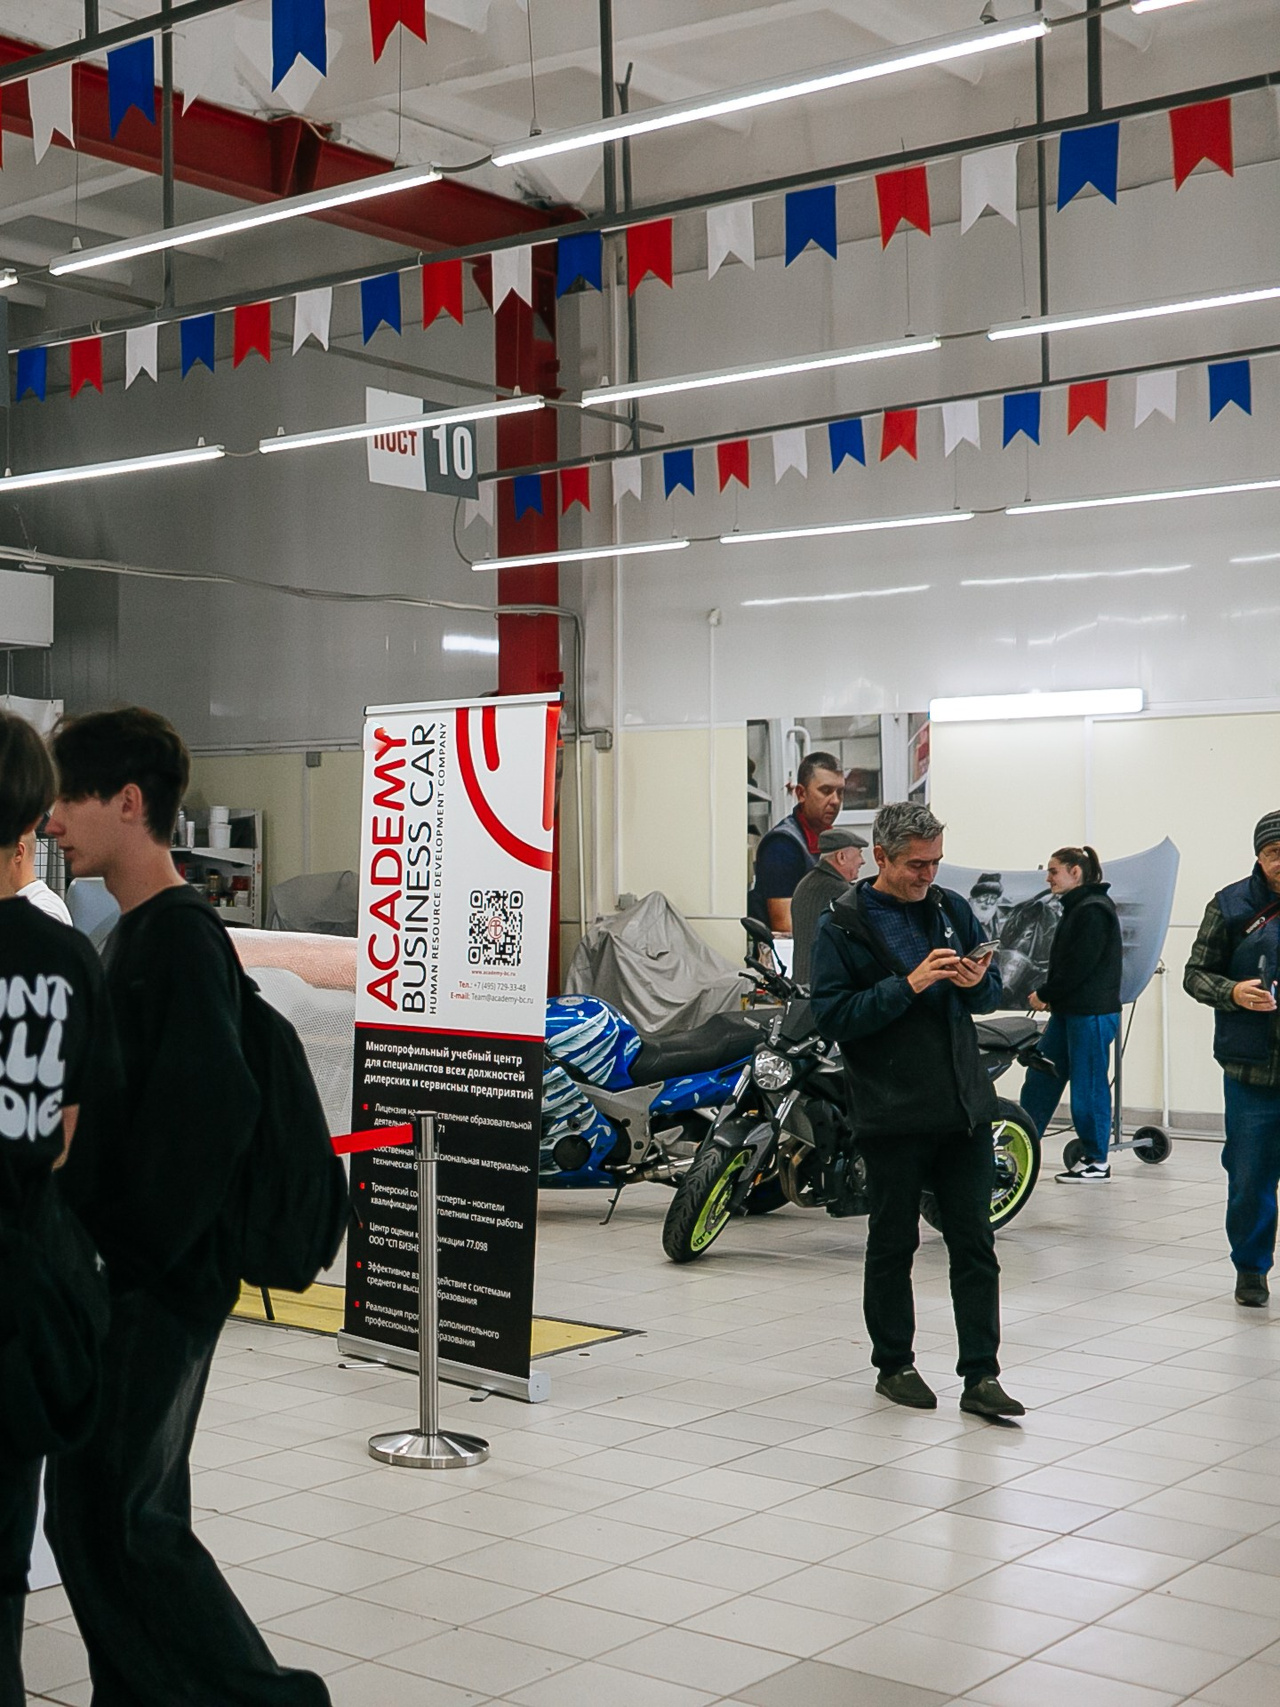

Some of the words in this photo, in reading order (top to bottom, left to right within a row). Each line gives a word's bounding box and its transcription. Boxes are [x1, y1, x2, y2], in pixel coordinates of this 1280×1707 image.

[432, 424, 473, 480] 10
[410, 723, 436, 807] CAR
[438, 723, 447, 787] COMPANY
[434, 791, 444, 887] DEVELOPMENT
[366, 726, 407, 1012] ACADEMY
[402, 821, 432, 1013] BUSINESS
[432, 892, 441, 959] RESOURCE
[471, 969, 516, 977] www.academy-bc.ru
[429, 964, 439, 1015] HUMAN
[450, 991, 470, 1000] E-mail:
[471, 993, 534, 1004] Team@academy-bc.ru
[365, 1041, 450, 1058] Многопрофильный
[451, 1049, 492, 1061] учебный
[493, 1054, 523, 1067] центр
[364, 1058, 381, 1069] для
[382, 1060, 444, 1074] специалистов
[445, 1066, 466, 1076] всех
[467, 1068, 526, 1082] должностей
[364, 1074, 411, 1087] дилерских
[412, 1079, 418, 1087] и
[420, 1079, 469, 1093] сервисных
[470, 1084, 534, 1100] предприятий
[374, 1103, 407, 1115] Лицензия
[437, 1112, 469, 1123] ствление
[470, 1114, 532, 1130] образовательной
[372, 1157, 413, 1169] техническая
[439, 1153, 480, 1166] сиональная
[481, 1159, 531, 1173] материально-
[371, 1182, 409, 1196] Тренерский
[437, 1195, 467, 1206] сперты
[472, 1201, 505, 1212] носители
[371, 1197, 418, 1212] квалификации
[436, 1208, 469, 1220] голетним
[470, 1213, 495, 1224] стажем
[496, 1218, 524, 1230] работы
[368, 1235, 385, 1246] ООО
[398, 1241, 419, 1253] БИЗНЕ
[369, 1222, 390, 1235] Центр
[390, 1227, 414, 1237] оценки
[367, 1276, 397, 1289] среднего
[437, 1288, 478, 1306] бразования
[368, 1261, 411, 1278] Эффективное
[473, 1284, 511, 1299] системами
[365, 1301, 403, 1317] Реализация
[439, 1319, 500, 1340] дополнительного
[365, 1315, 419, 1334] профессиональн
[436, 1330, 476, 1348] разования
